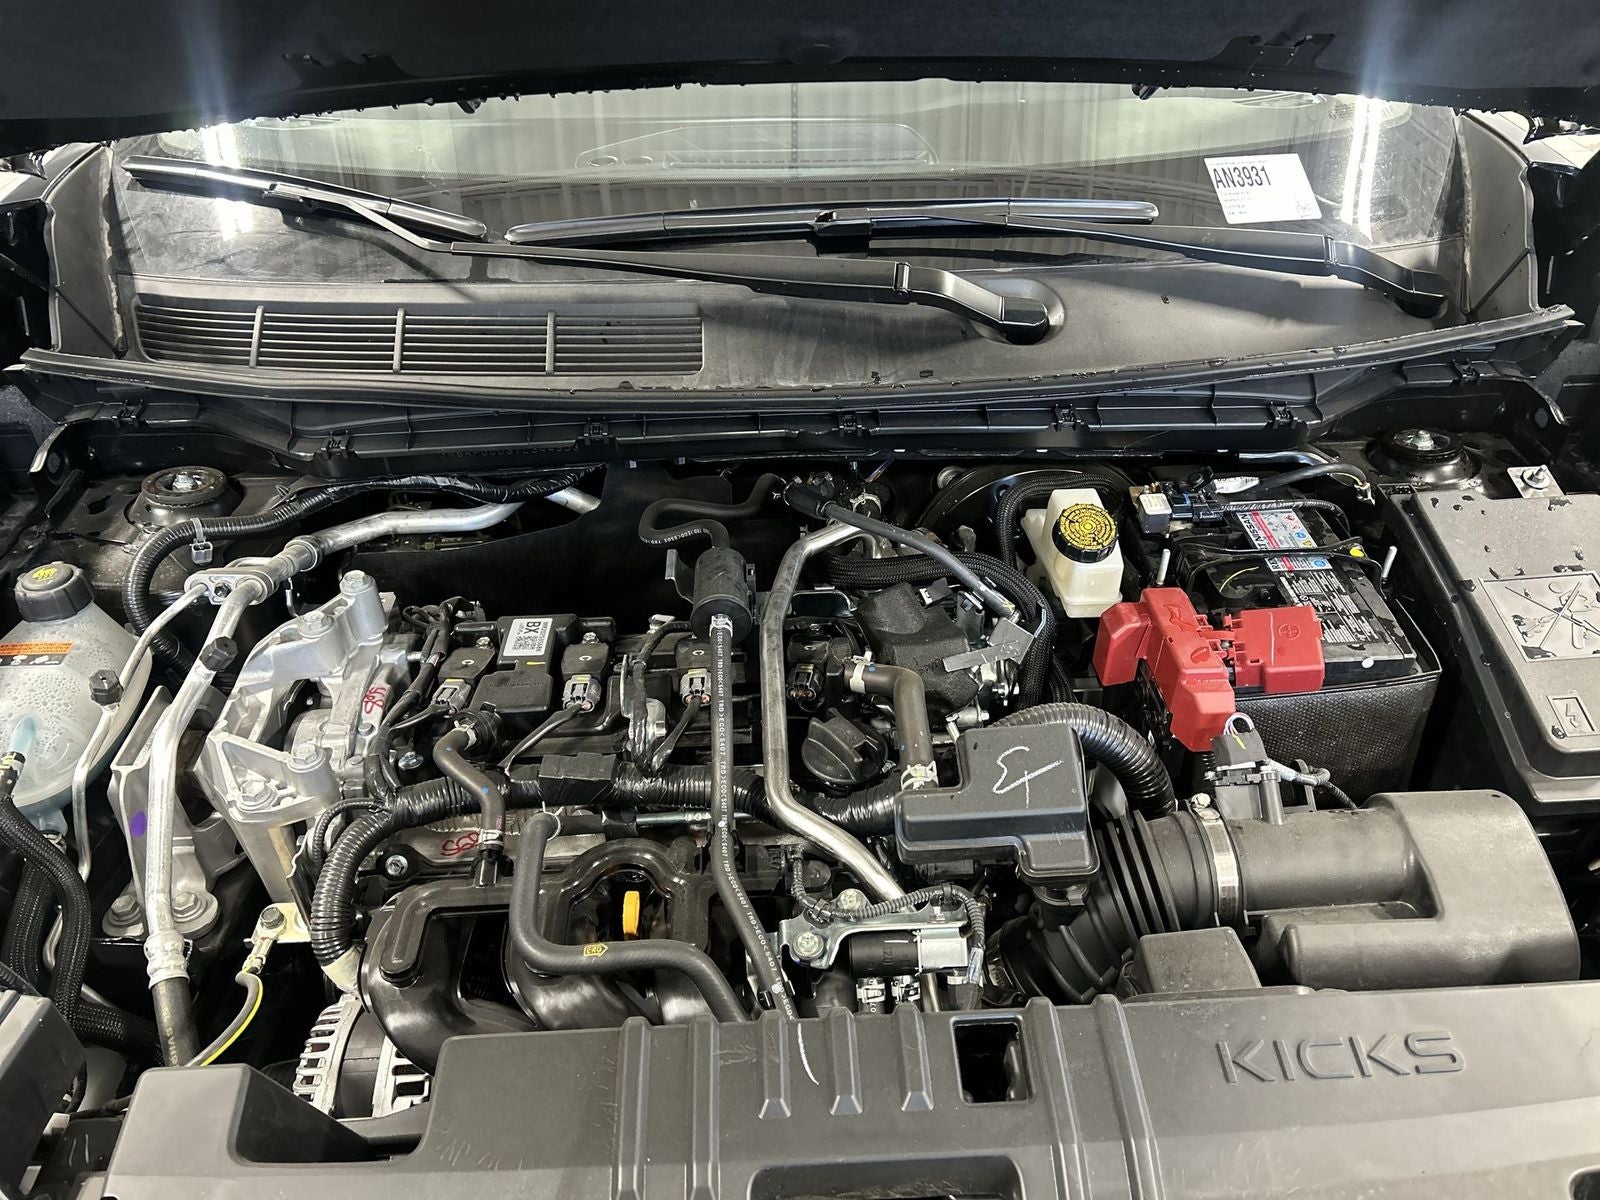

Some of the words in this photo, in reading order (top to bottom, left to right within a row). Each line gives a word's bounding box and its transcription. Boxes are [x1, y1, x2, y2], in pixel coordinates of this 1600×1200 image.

[1213, 165, 1271, 188] AN3931
[1240, 513, 1262, 541] NISSAN
[524, 621, 541, 634] BX
[1216, 1031, 1466, 1084] KICKS
